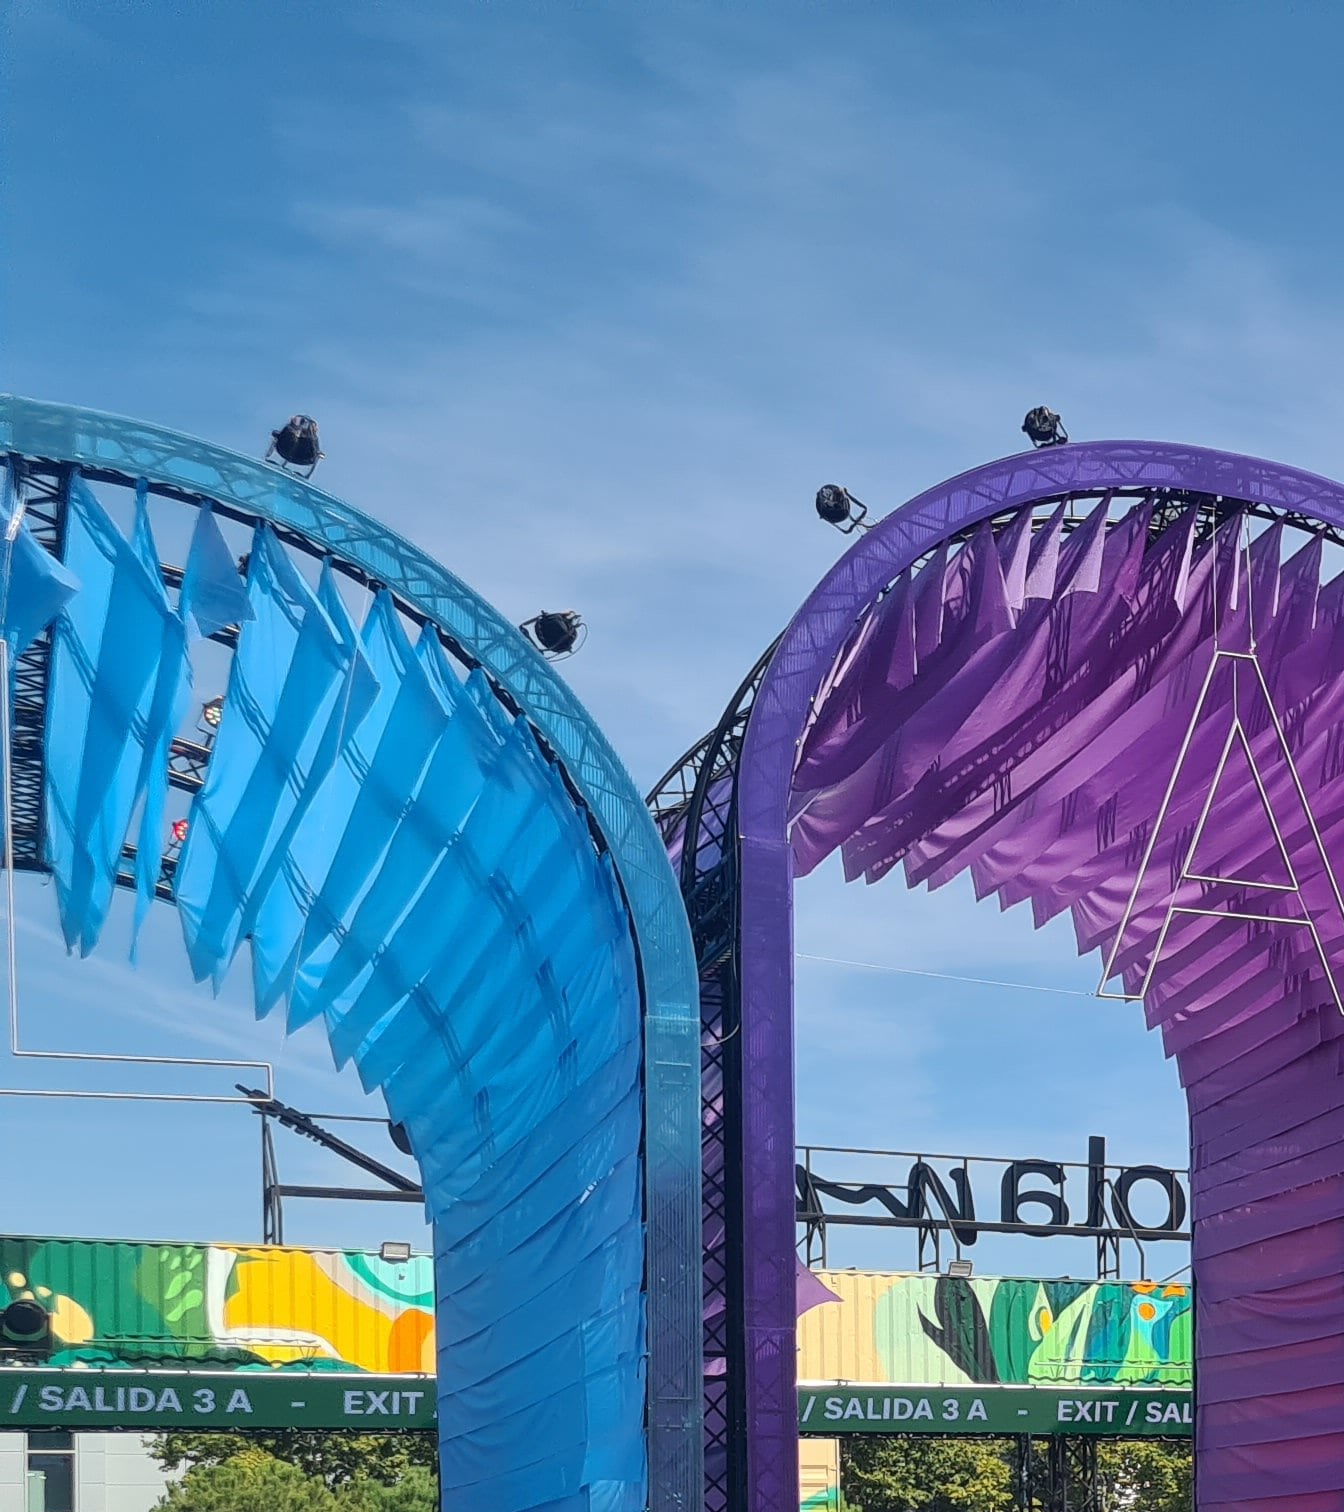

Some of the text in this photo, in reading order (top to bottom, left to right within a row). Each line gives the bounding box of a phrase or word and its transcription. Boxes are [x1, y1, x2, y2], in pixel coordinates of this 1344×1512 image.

[38, 1386, 183, 1413] SALIDA
[193, 1388, 216, 1413] 3
[226, 1388, 254, 1414] A
[343, 1390, 424, 1416] EXIT
[823, 1397, 934, 1421] SALIDA
[942, 1398, 959, 1421] 3
[966, 1398, 989, 1422] A
[1057, 1400, 1119, 1423] EXIT
